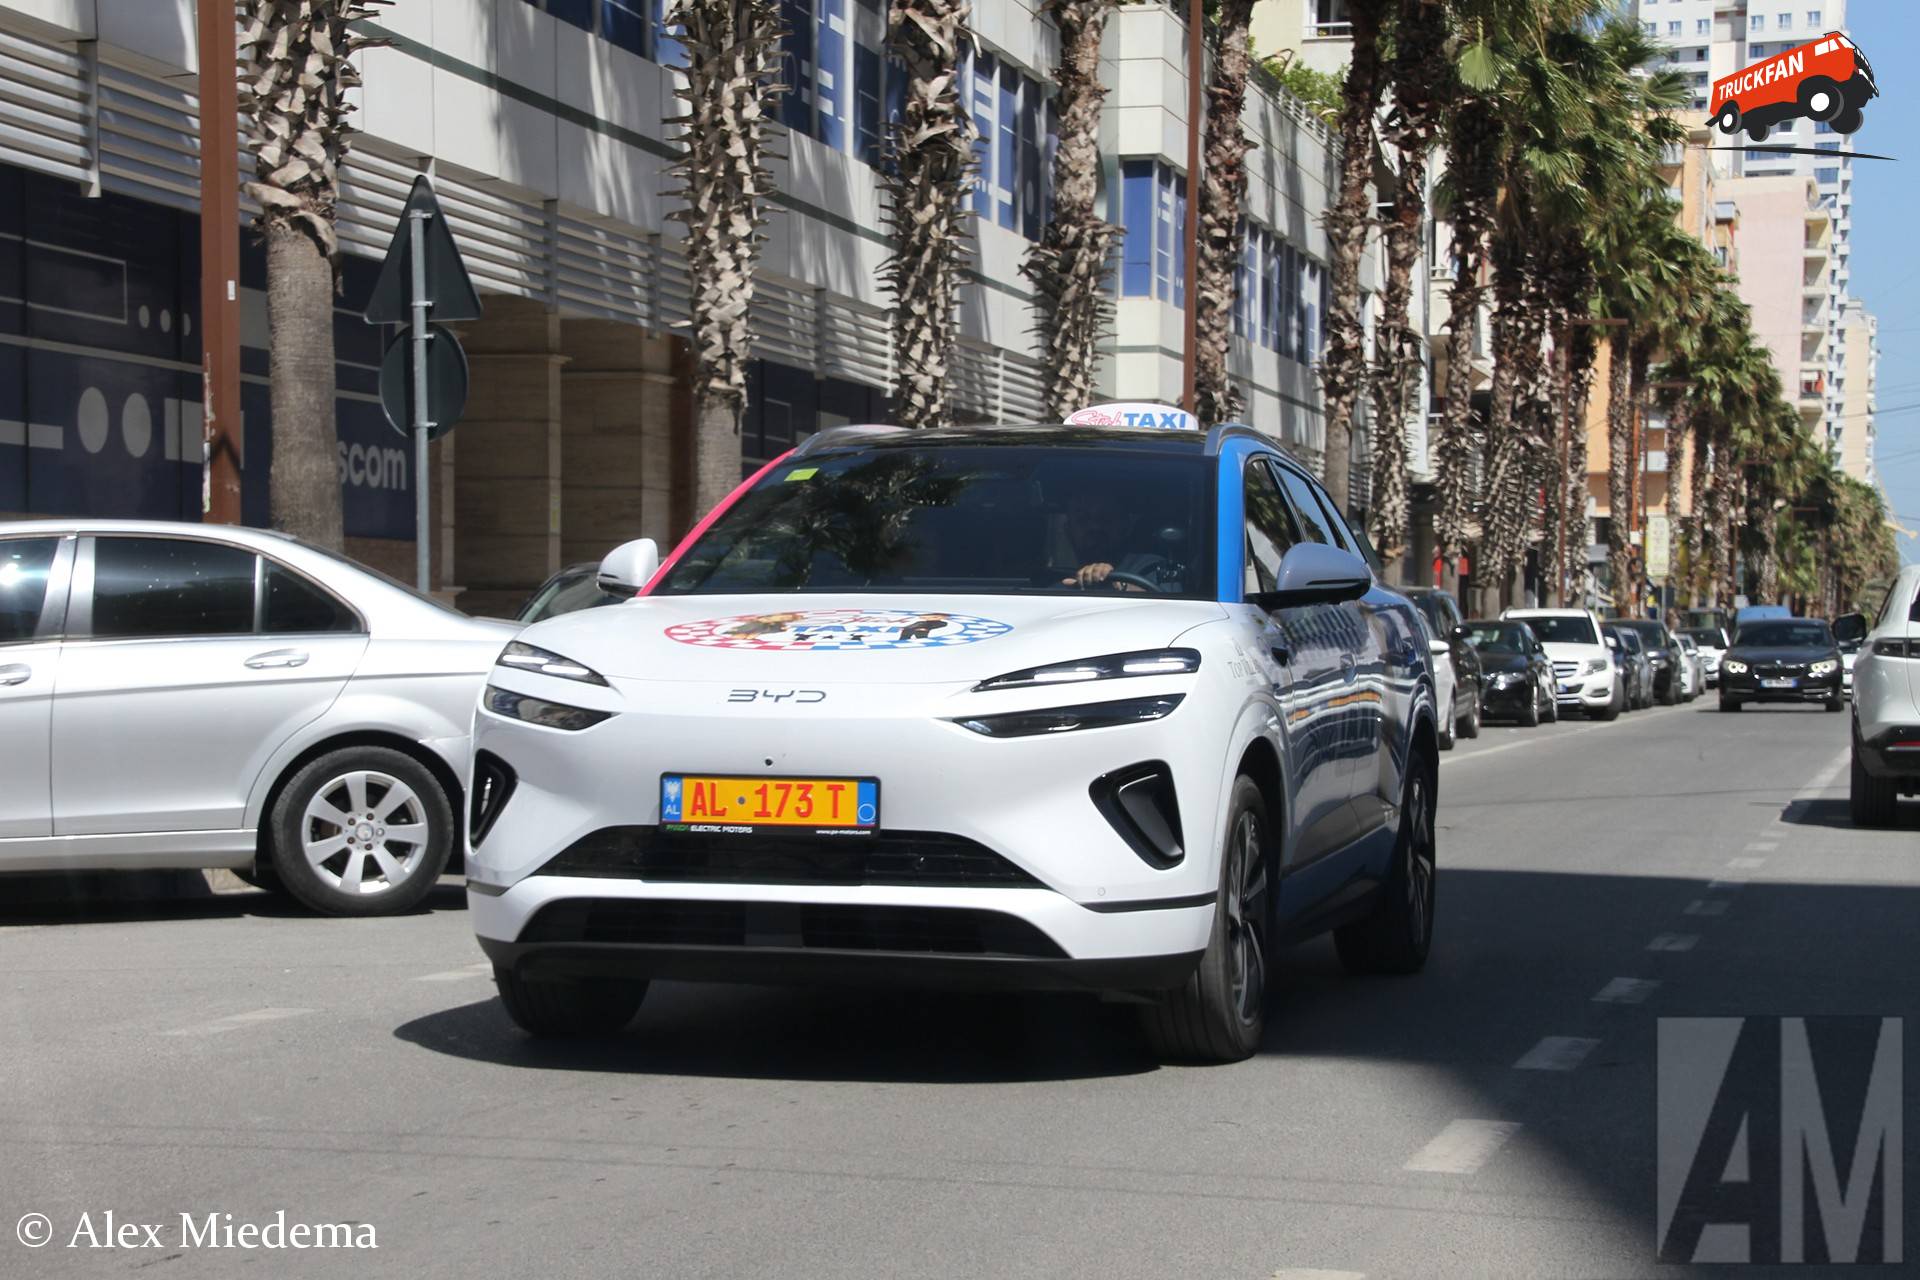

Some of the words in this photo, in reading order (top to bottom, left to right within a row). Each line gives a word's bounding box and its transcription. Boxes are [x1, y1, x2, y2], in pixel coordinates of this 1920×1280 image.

[1123, 412, 1187, 429] TAXI
[727, 689, 827, 703] BYD
[690, 781, 728, 817] AL
[753, 783, 814, 818] 173
[826, 784, 846, 819] T
[664, 804, 681, 815] AL
[690, 824, 722, 833] ELECTRIC
[722, 825, 753, 834] MOTORS
